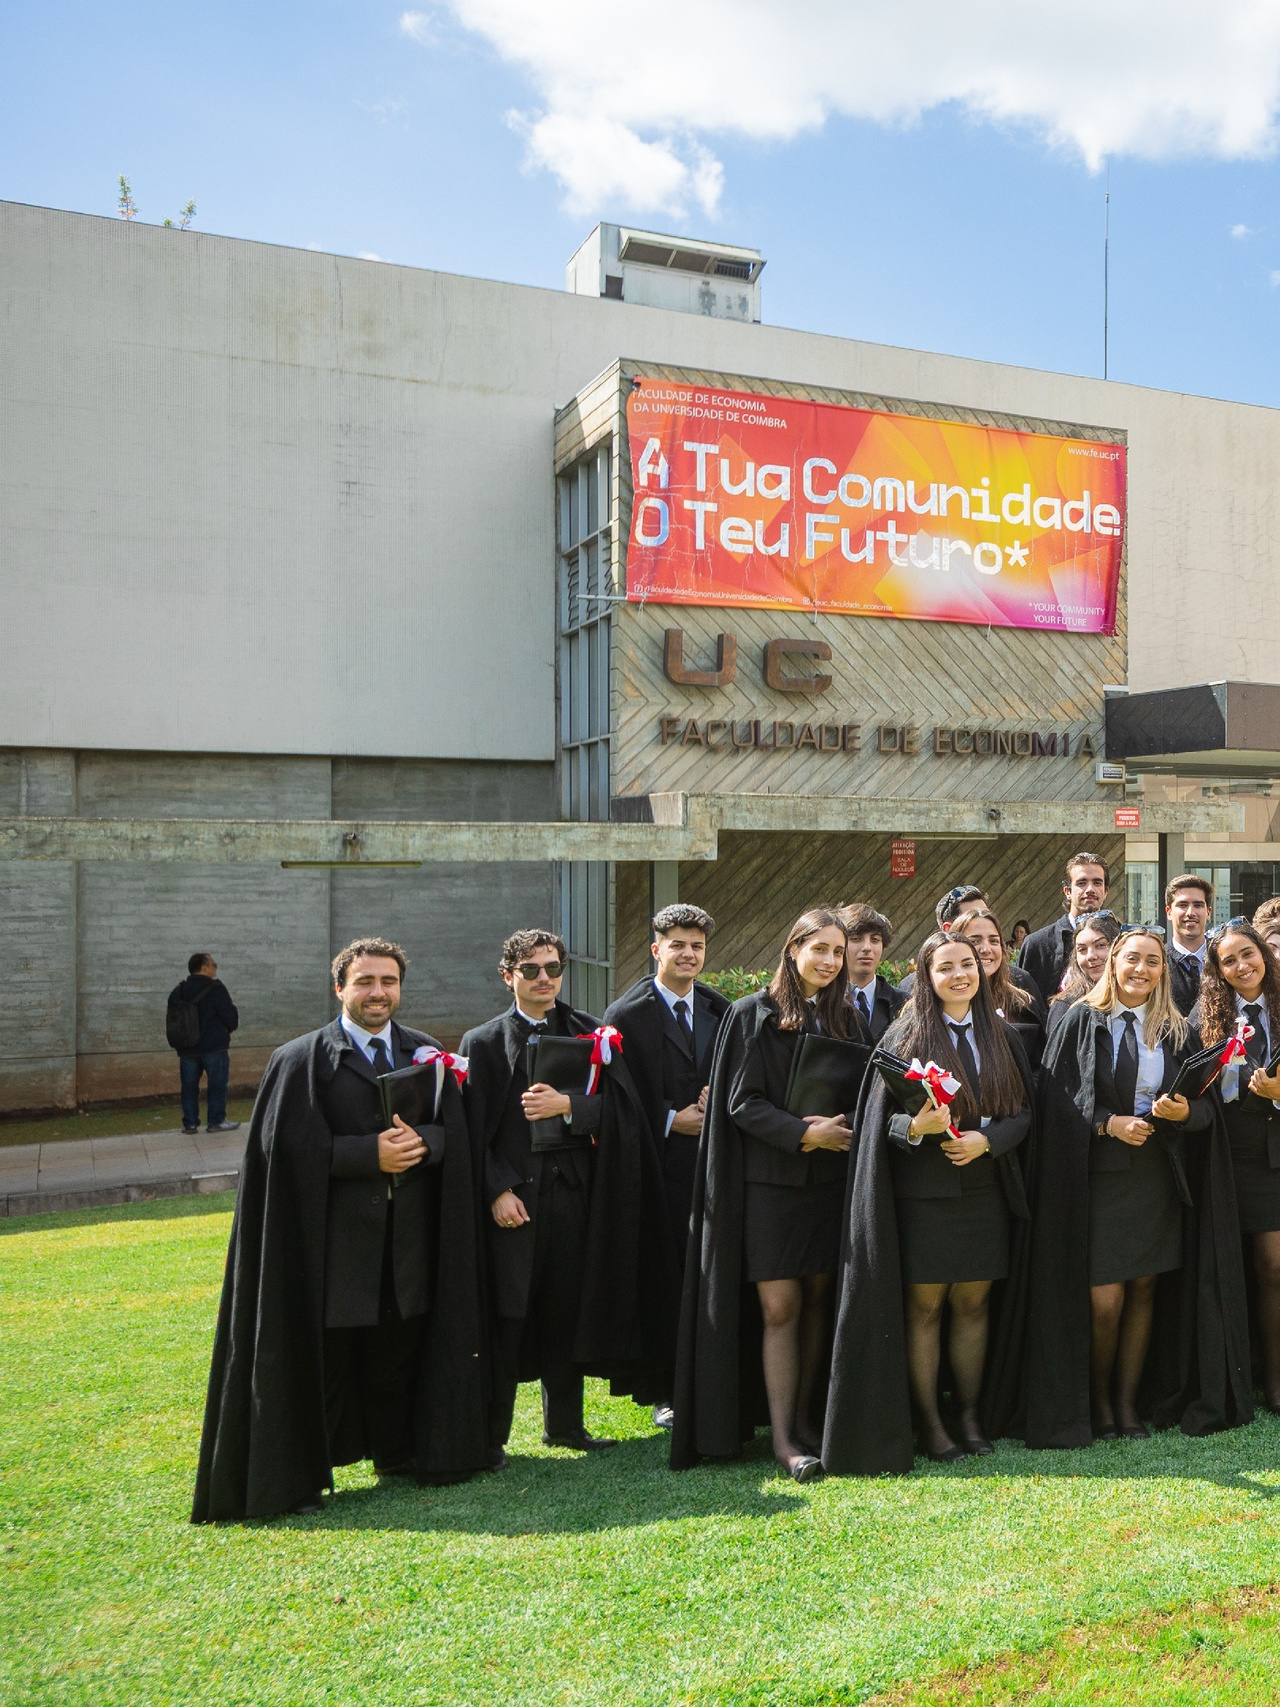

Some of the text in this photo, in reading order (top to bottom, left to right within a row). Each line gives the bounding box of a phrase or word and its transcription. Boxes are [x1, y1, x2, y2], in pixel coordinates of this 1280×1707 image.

[632, 389, 767, 412] FACULDADE DE ECONOMIA
[633, 402, 650, 413] DA
[726, 411, 740, 423] DE
[741, 413, 788, 429] COIMBRA
[1067, 447, 1120, 462] www.fe.uc.pt
[638, 437, 1121, 537] A Tua Comunidade
[634, 496, 670, 547] O
[683, 499, 790, 558] Teu
[1033, 614, 1087, 627] YOUR FUTURE
[1056, 604, 1106, 616] COMMUNITY
[660, 716, 1096, 759] FACULDADE DE ECONOMIA
